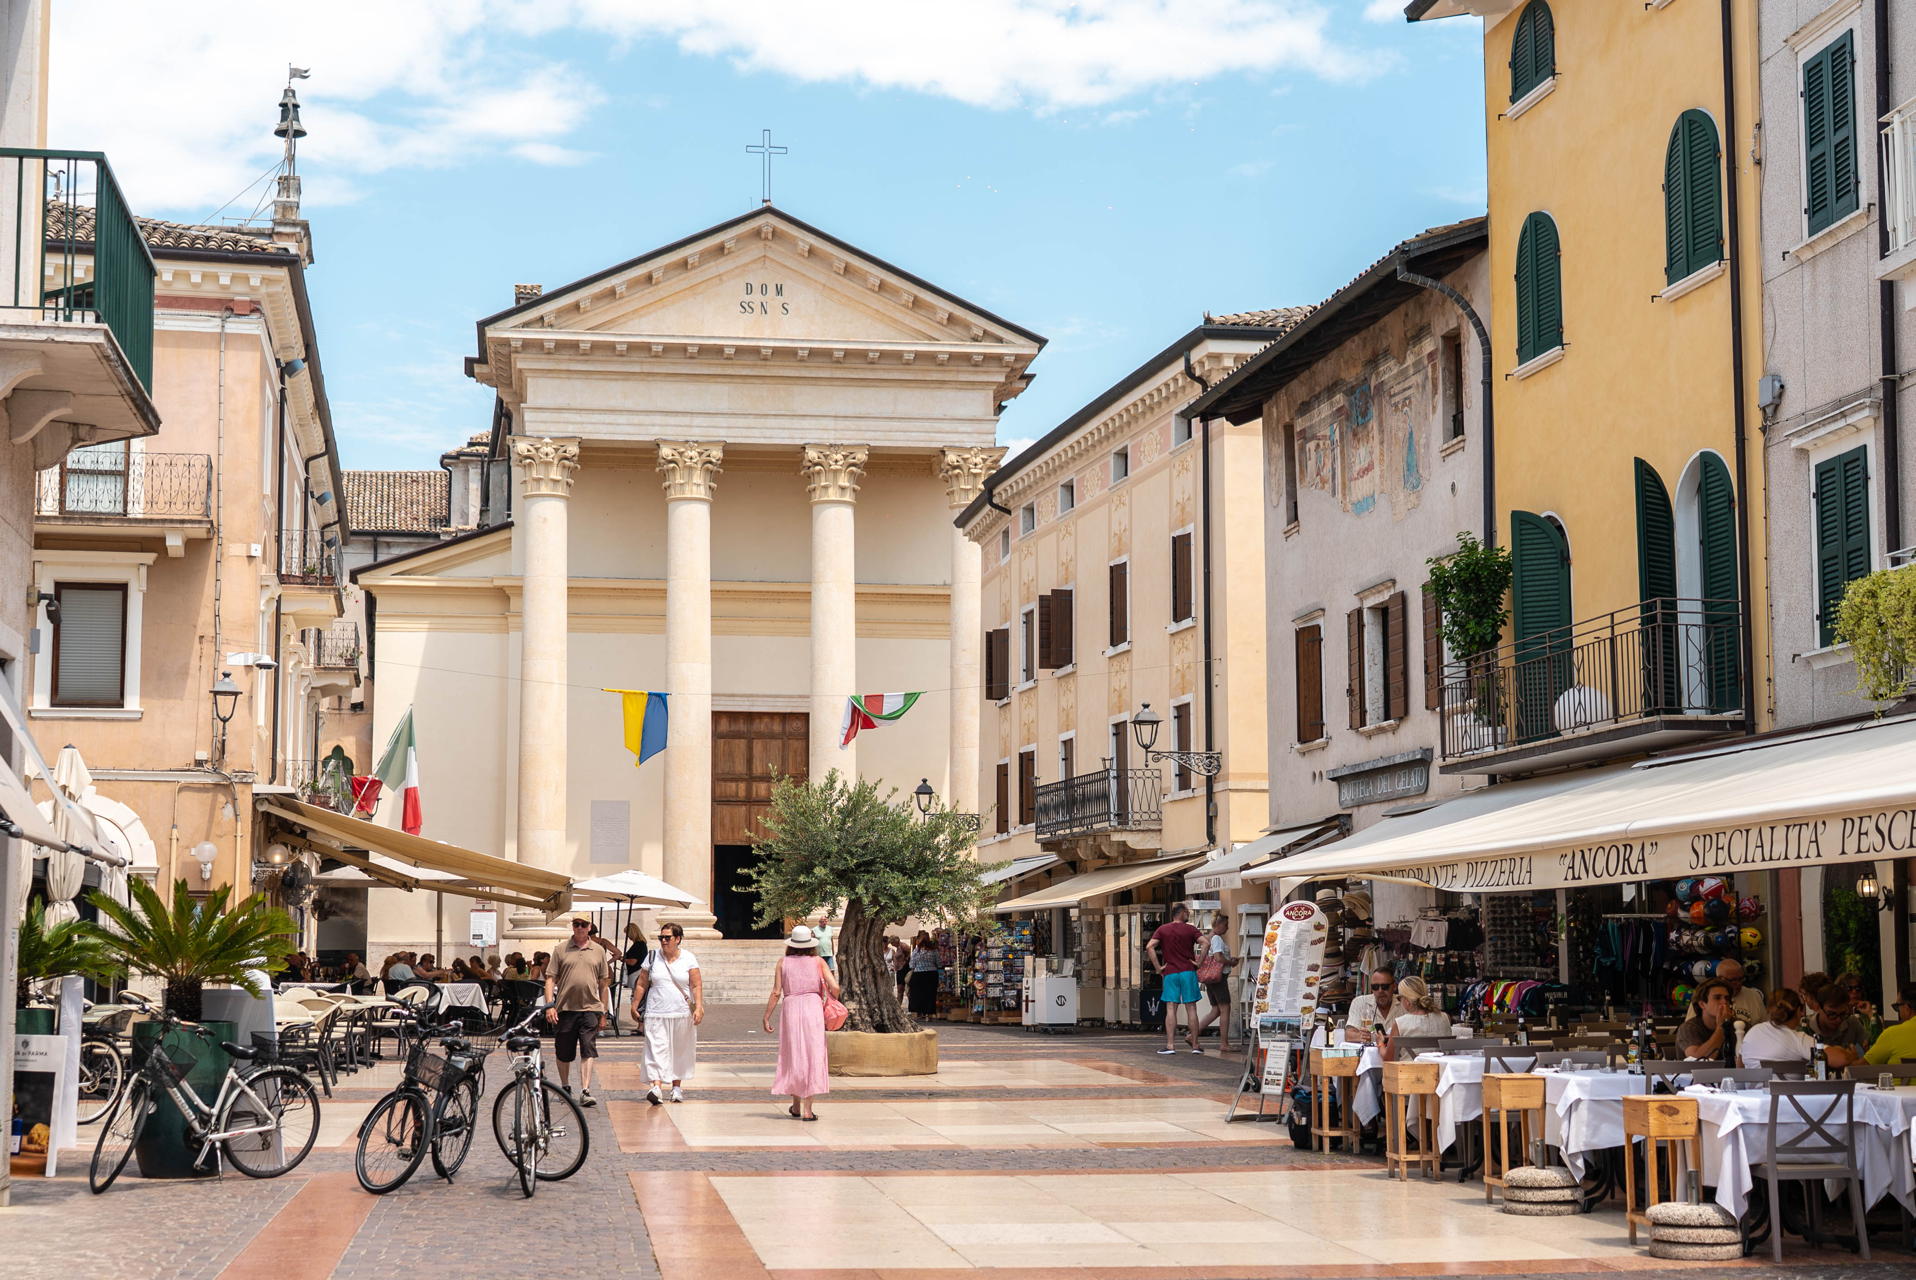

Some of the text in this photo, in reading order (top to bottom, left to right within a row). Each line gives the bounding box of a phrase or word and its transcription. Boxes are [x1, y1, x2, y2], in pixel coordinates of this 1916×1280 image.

[1341, 766, 1425, 801] BOTTEGA DEL GELATO
[1380, 863, 1459, 888] RANTE
[1461, 855, 1533, 888] PIZZERIA
[1559, 840, 1658, 881] "ANCORA"
[1689, 819, 1827, 870] SPECIALITA'
